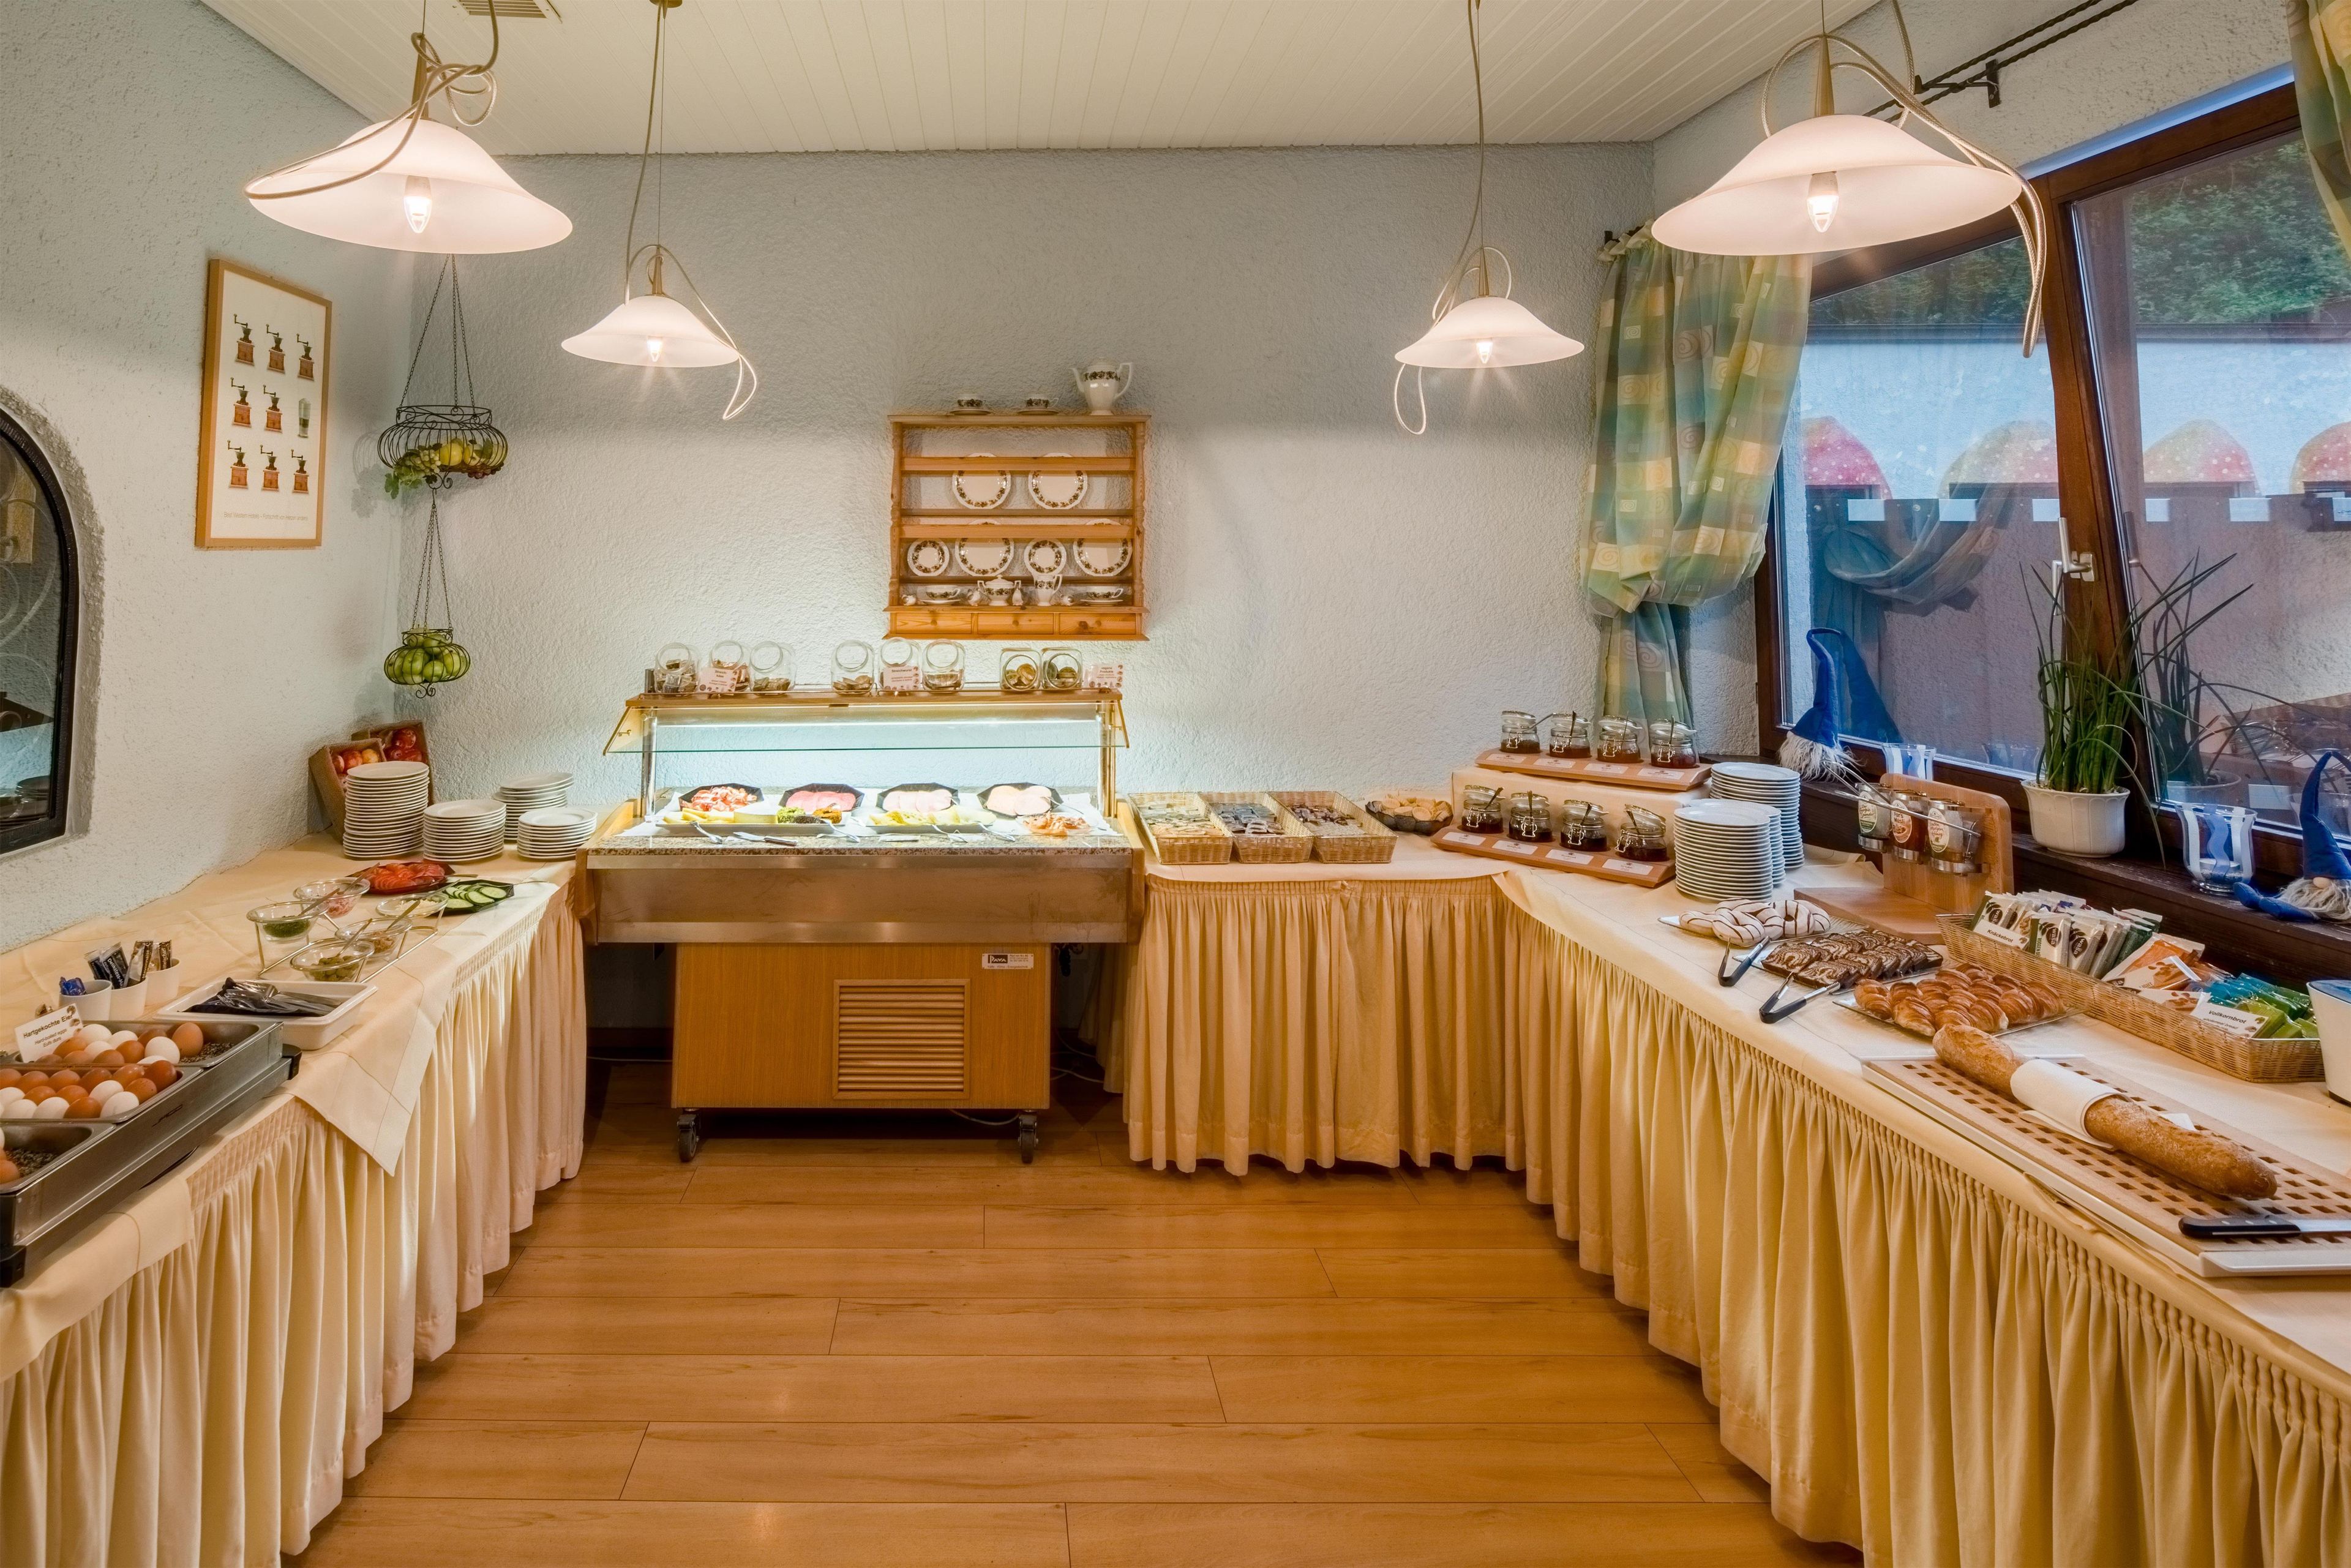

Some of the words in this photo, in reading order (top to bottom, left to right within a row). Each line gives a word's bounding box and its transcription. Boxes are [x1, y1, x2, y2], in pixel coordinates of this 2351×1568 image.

[1987, 929, 2014, 943] Knäckebrot
[2073, 938, 2085, 955] wasa
[2208, 1010, 2247, 1024] Vollkornbrot
[23, 1019, 61, 1039] Hartgekochte
[61, 1014, 73, 1023] Eier
[34, 1032, 57, 1045] Hard-boiled
